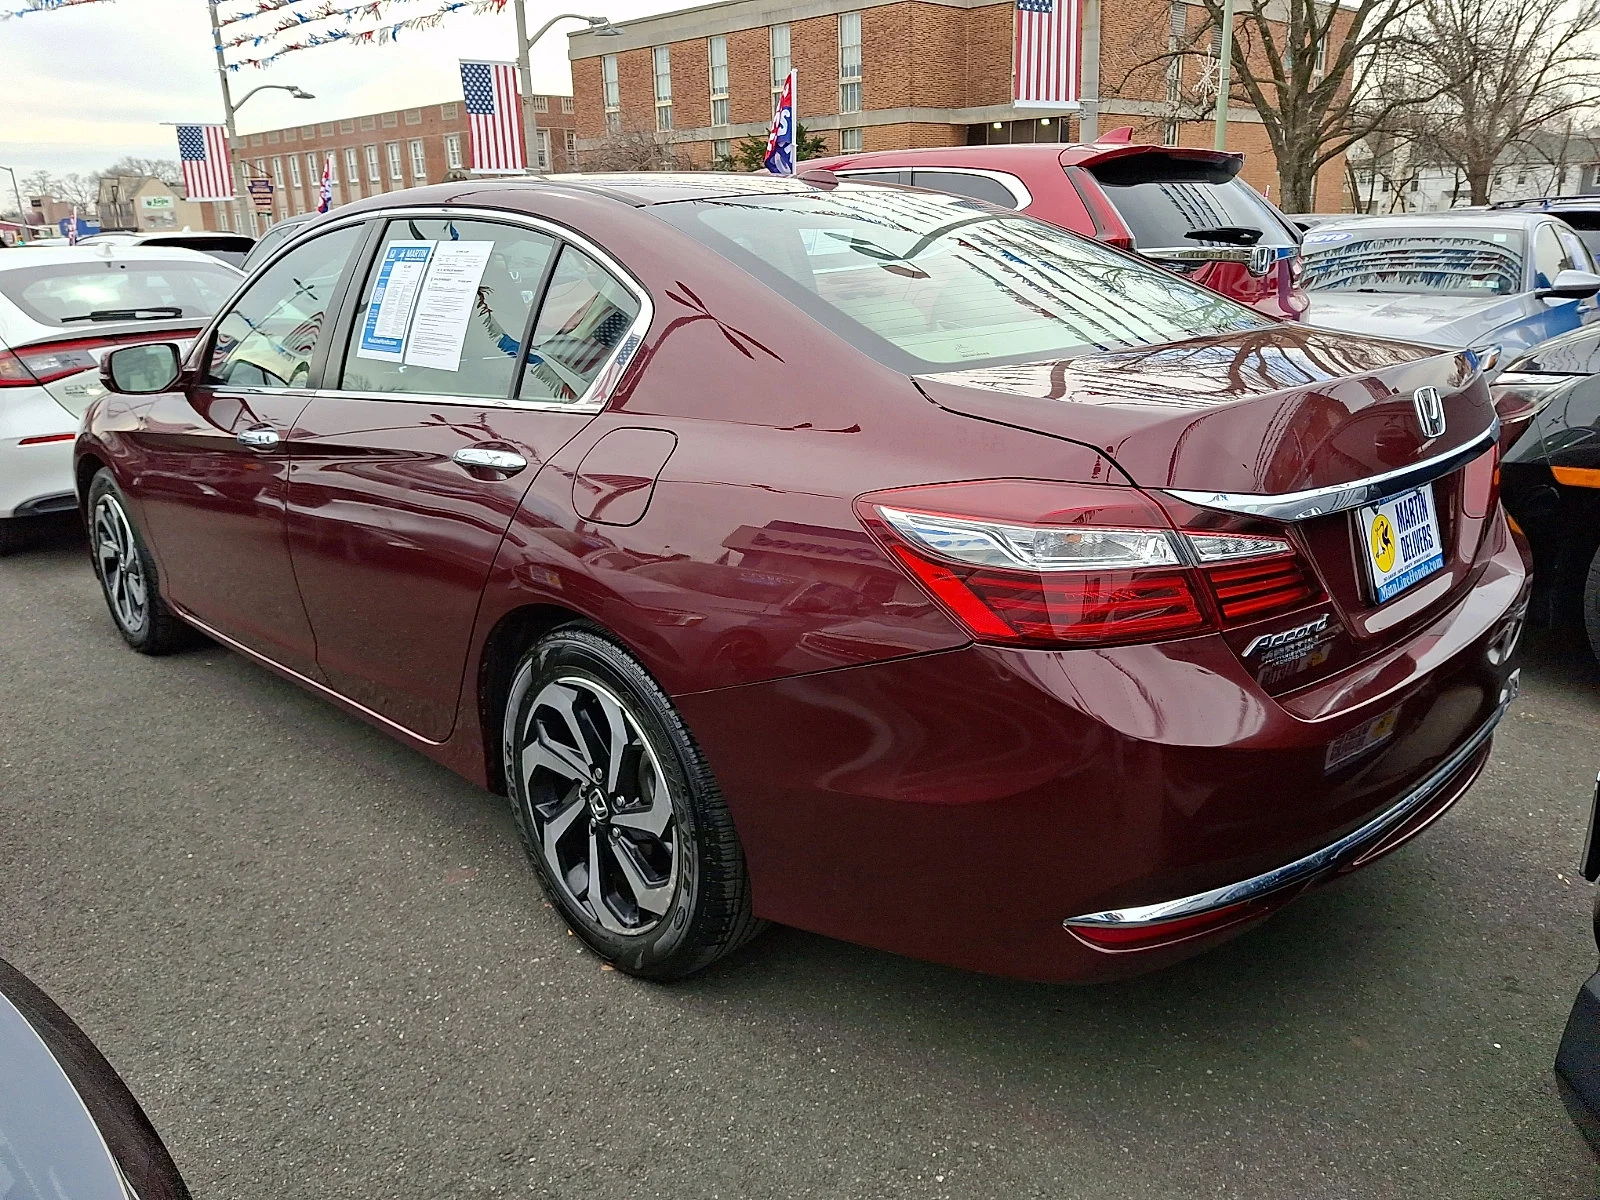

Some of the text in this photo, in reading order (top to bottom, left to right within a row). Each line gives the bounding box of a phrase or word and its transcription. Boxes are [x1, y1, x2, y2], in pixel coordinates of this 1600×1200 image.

[406, 249, 429, 258] MARTIN
[1395, 492, 1429, 534] MARTIN
[1401, 523, 1434, 563] DELIVERS
[1241, 613, 1330, 657] Accord
